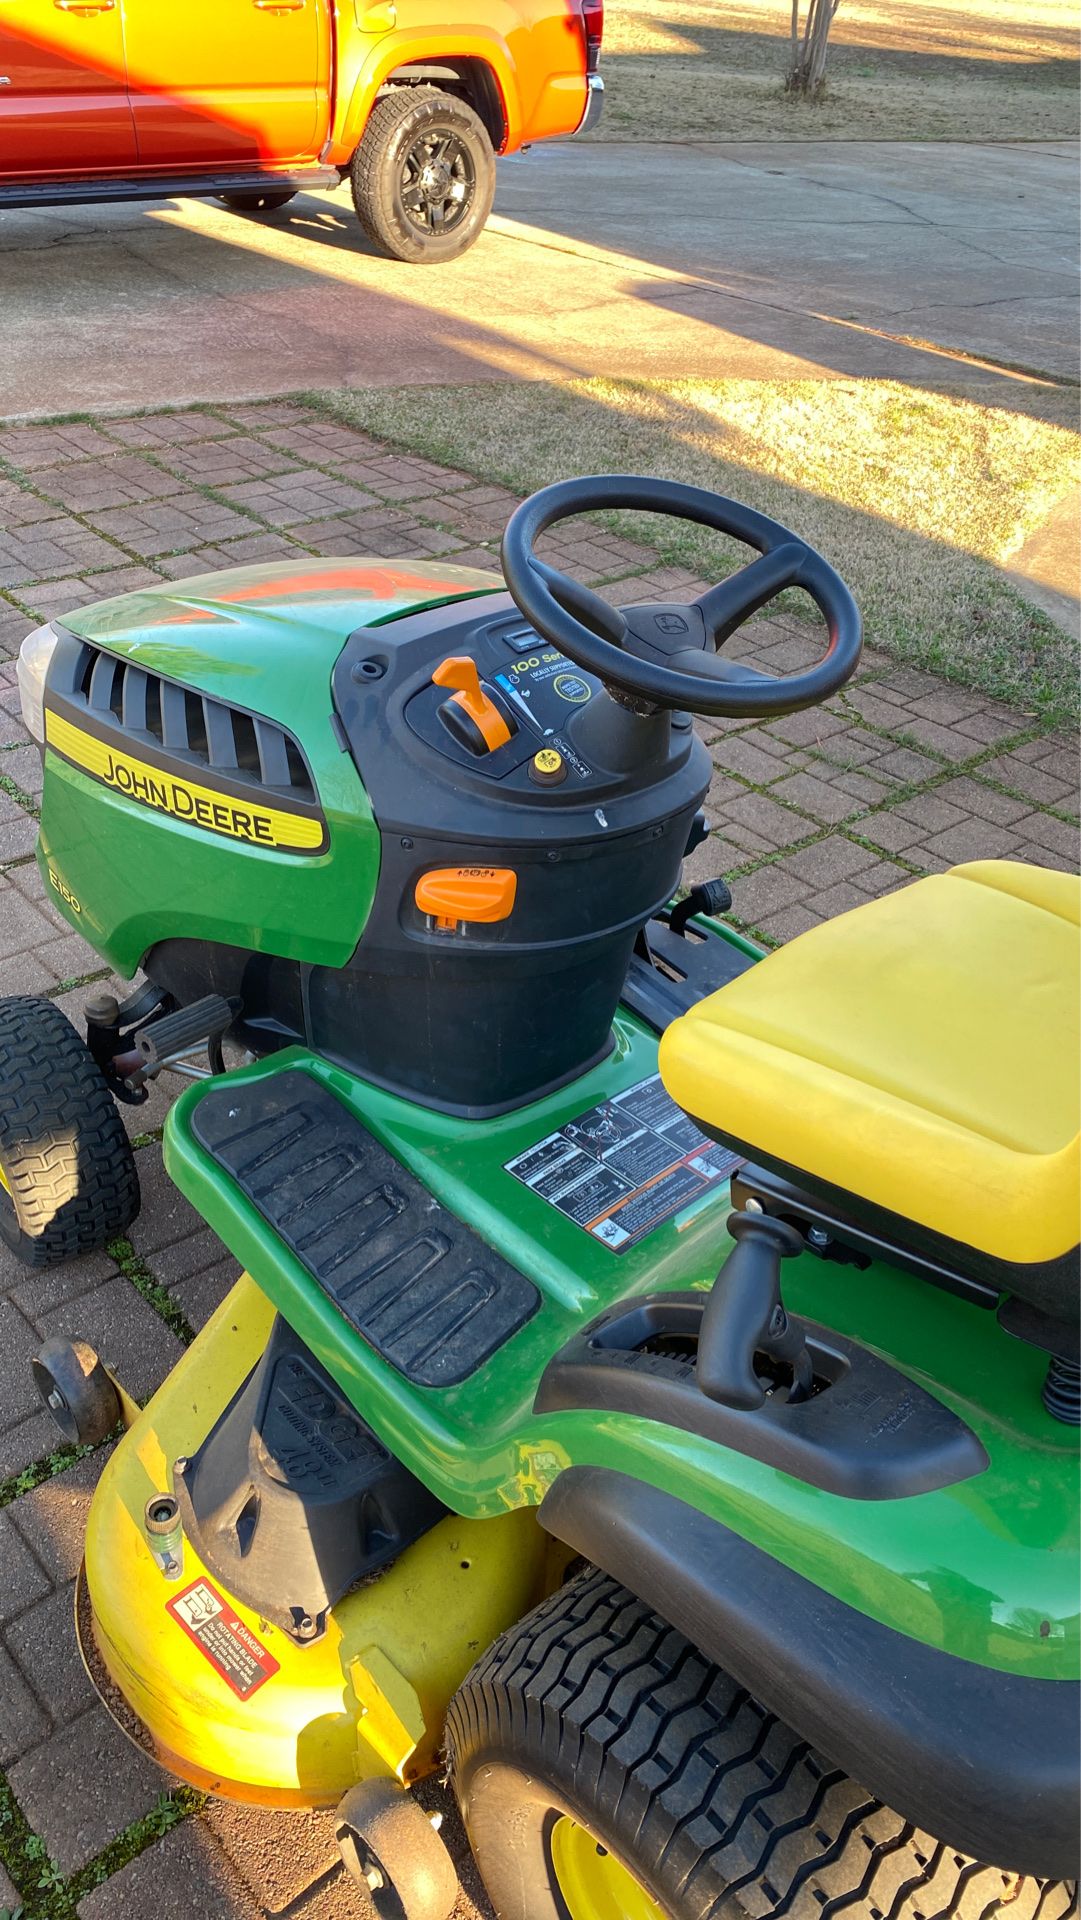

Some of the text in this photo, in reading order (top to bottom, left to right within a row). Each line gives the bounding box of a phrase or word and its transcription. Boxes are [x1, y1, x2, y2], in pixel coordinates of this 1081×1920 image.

[511, 657, 540, 675] 100
[542, 652, 563, 662] Ser
[103, 755, 274, 842] JOHN DEERE
[48, 867, 81, 913] E150
[197, 1630, 213, 1648] engine
[202, 1626, 253, 1686] under or into mower when
[207, 1621, 255, 1677] Do not put hands or feet
[216, 1621, 258, 1669] ROTATING BLADE
[236, 1626, 266, 1659] DANGER
